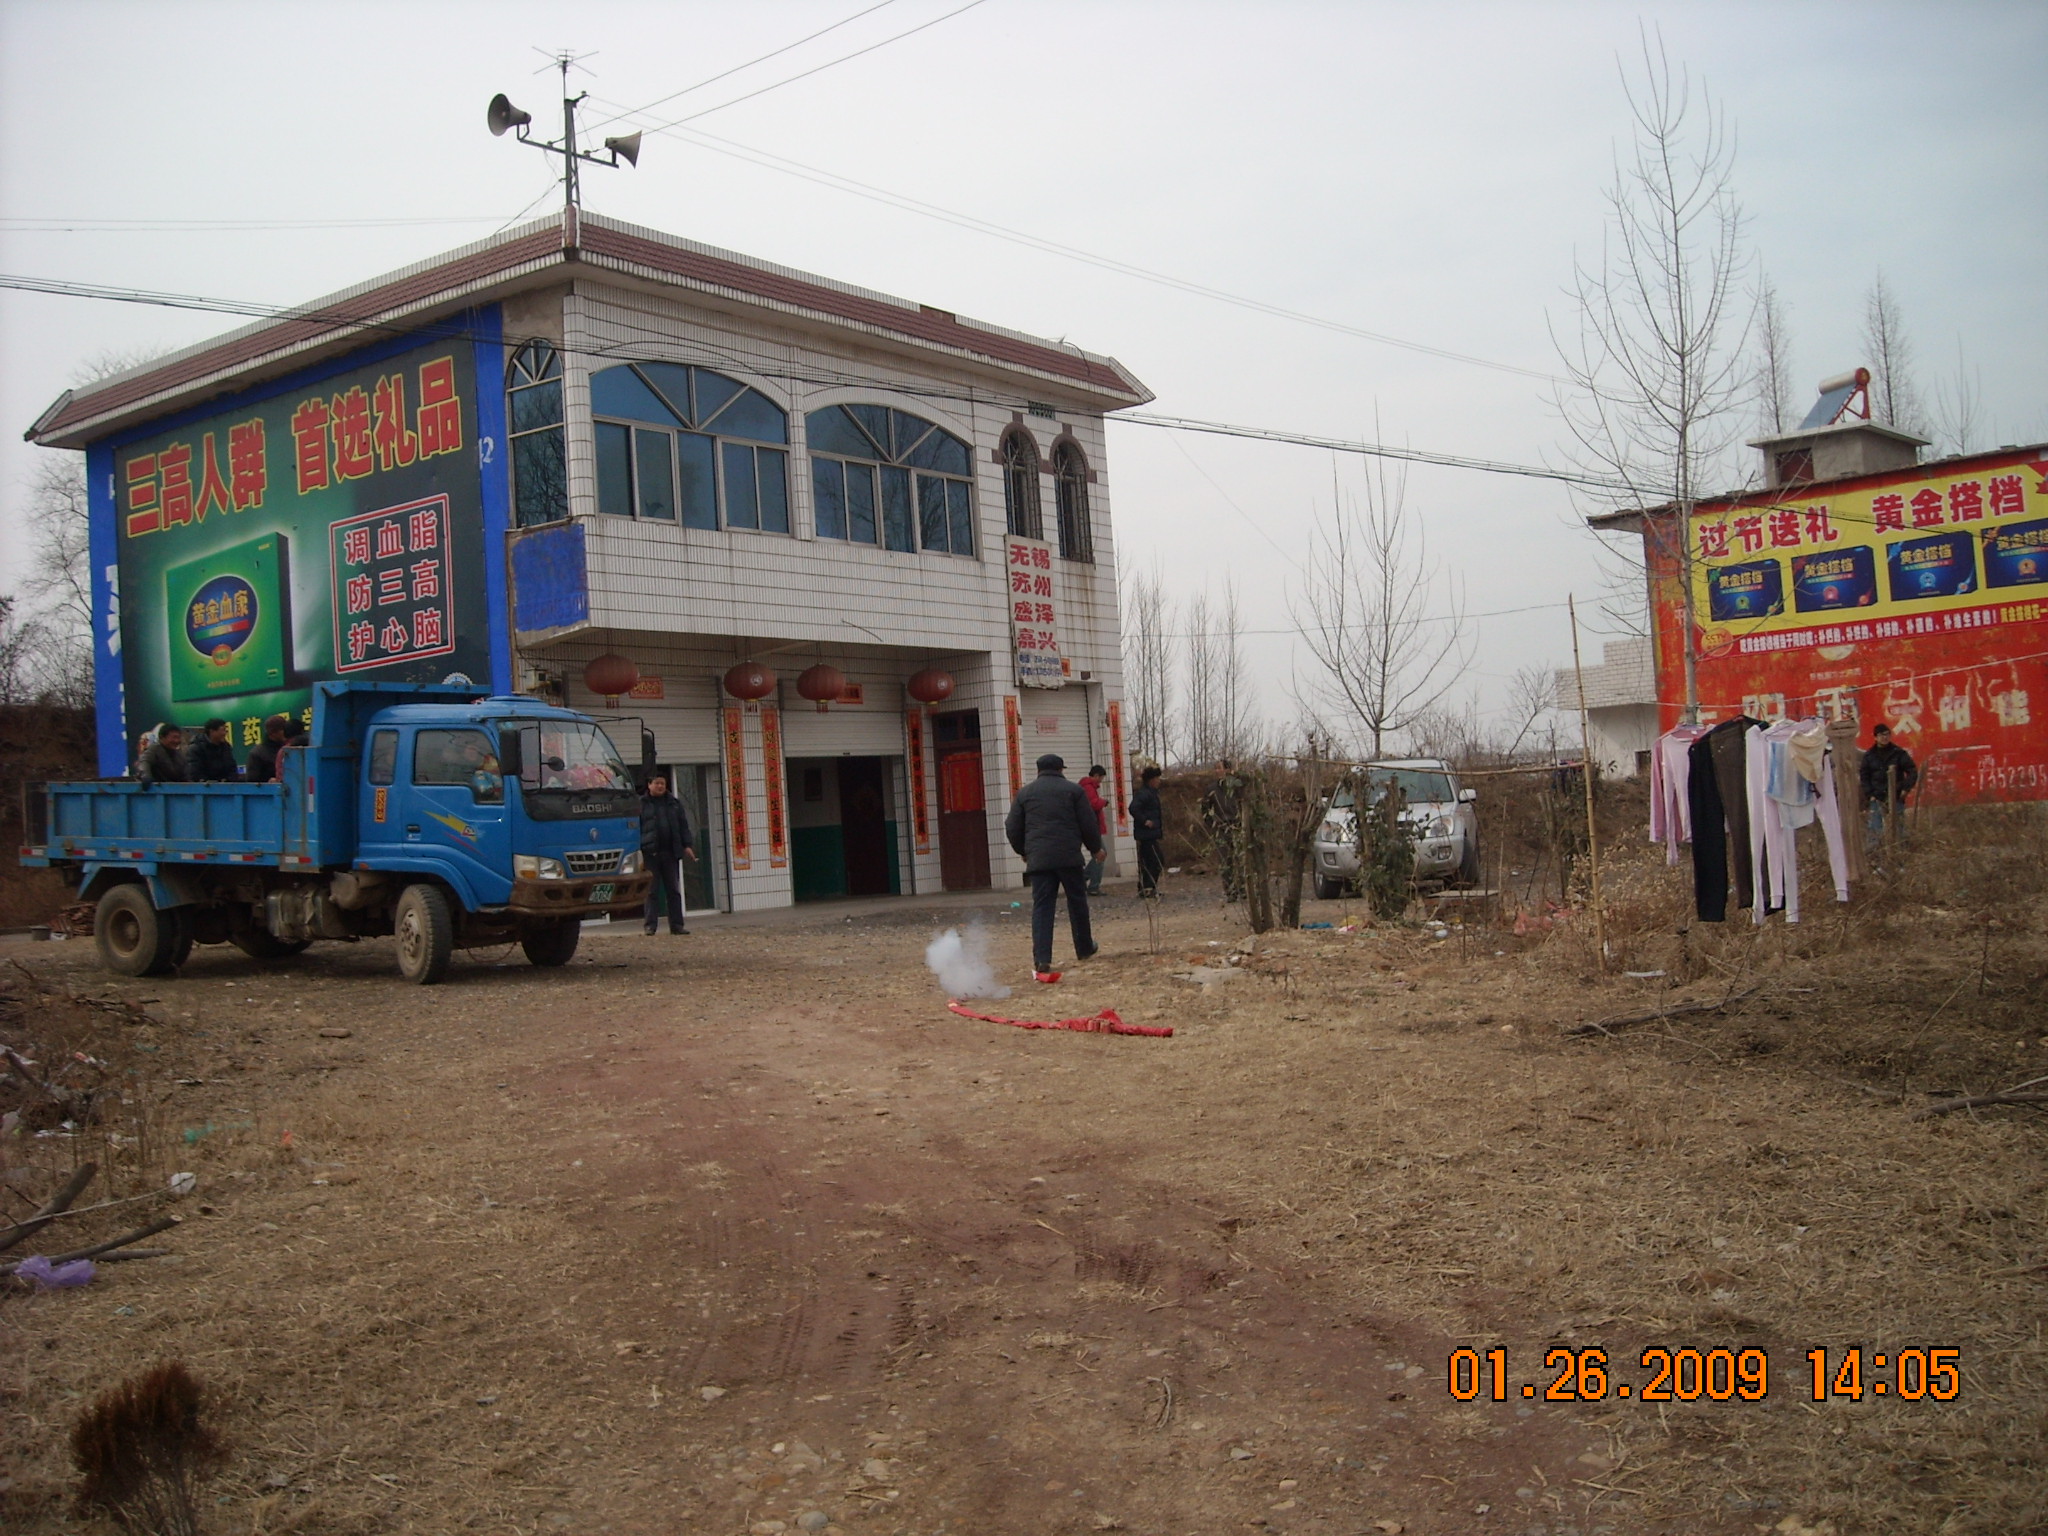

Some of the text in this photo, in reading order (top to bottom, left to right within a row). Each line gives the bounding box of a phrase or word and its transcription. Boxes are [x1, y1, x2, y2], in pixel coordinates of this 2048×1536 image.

[127, 355, 463, 538] 三高人群 首选礼品
[1698, 474, 2027, 559] 过节送礼 黄金搭档
[343, 509, 438, 566] 调血脂
[1009, 543, 1051, 570] 无锡
[1899, 541, 1954, 565] 黄金搭档
[1718, 570, 1764, 590] 黄金搭档
[1803, 556, 1856, 579] 黄金搭档
[346, 558, 441, 615] 防三高
[1011, 571, 1052, 598] 苏州
[191, 588, 250, 630] 黄金血康
[1014, 600, 1055, 625] 盛泽
[348, 607, 443, 661] 护心脑
[1017, 627, 1057, 651] 嘉兴
[1705, 631, 1727, 641] CCTV
